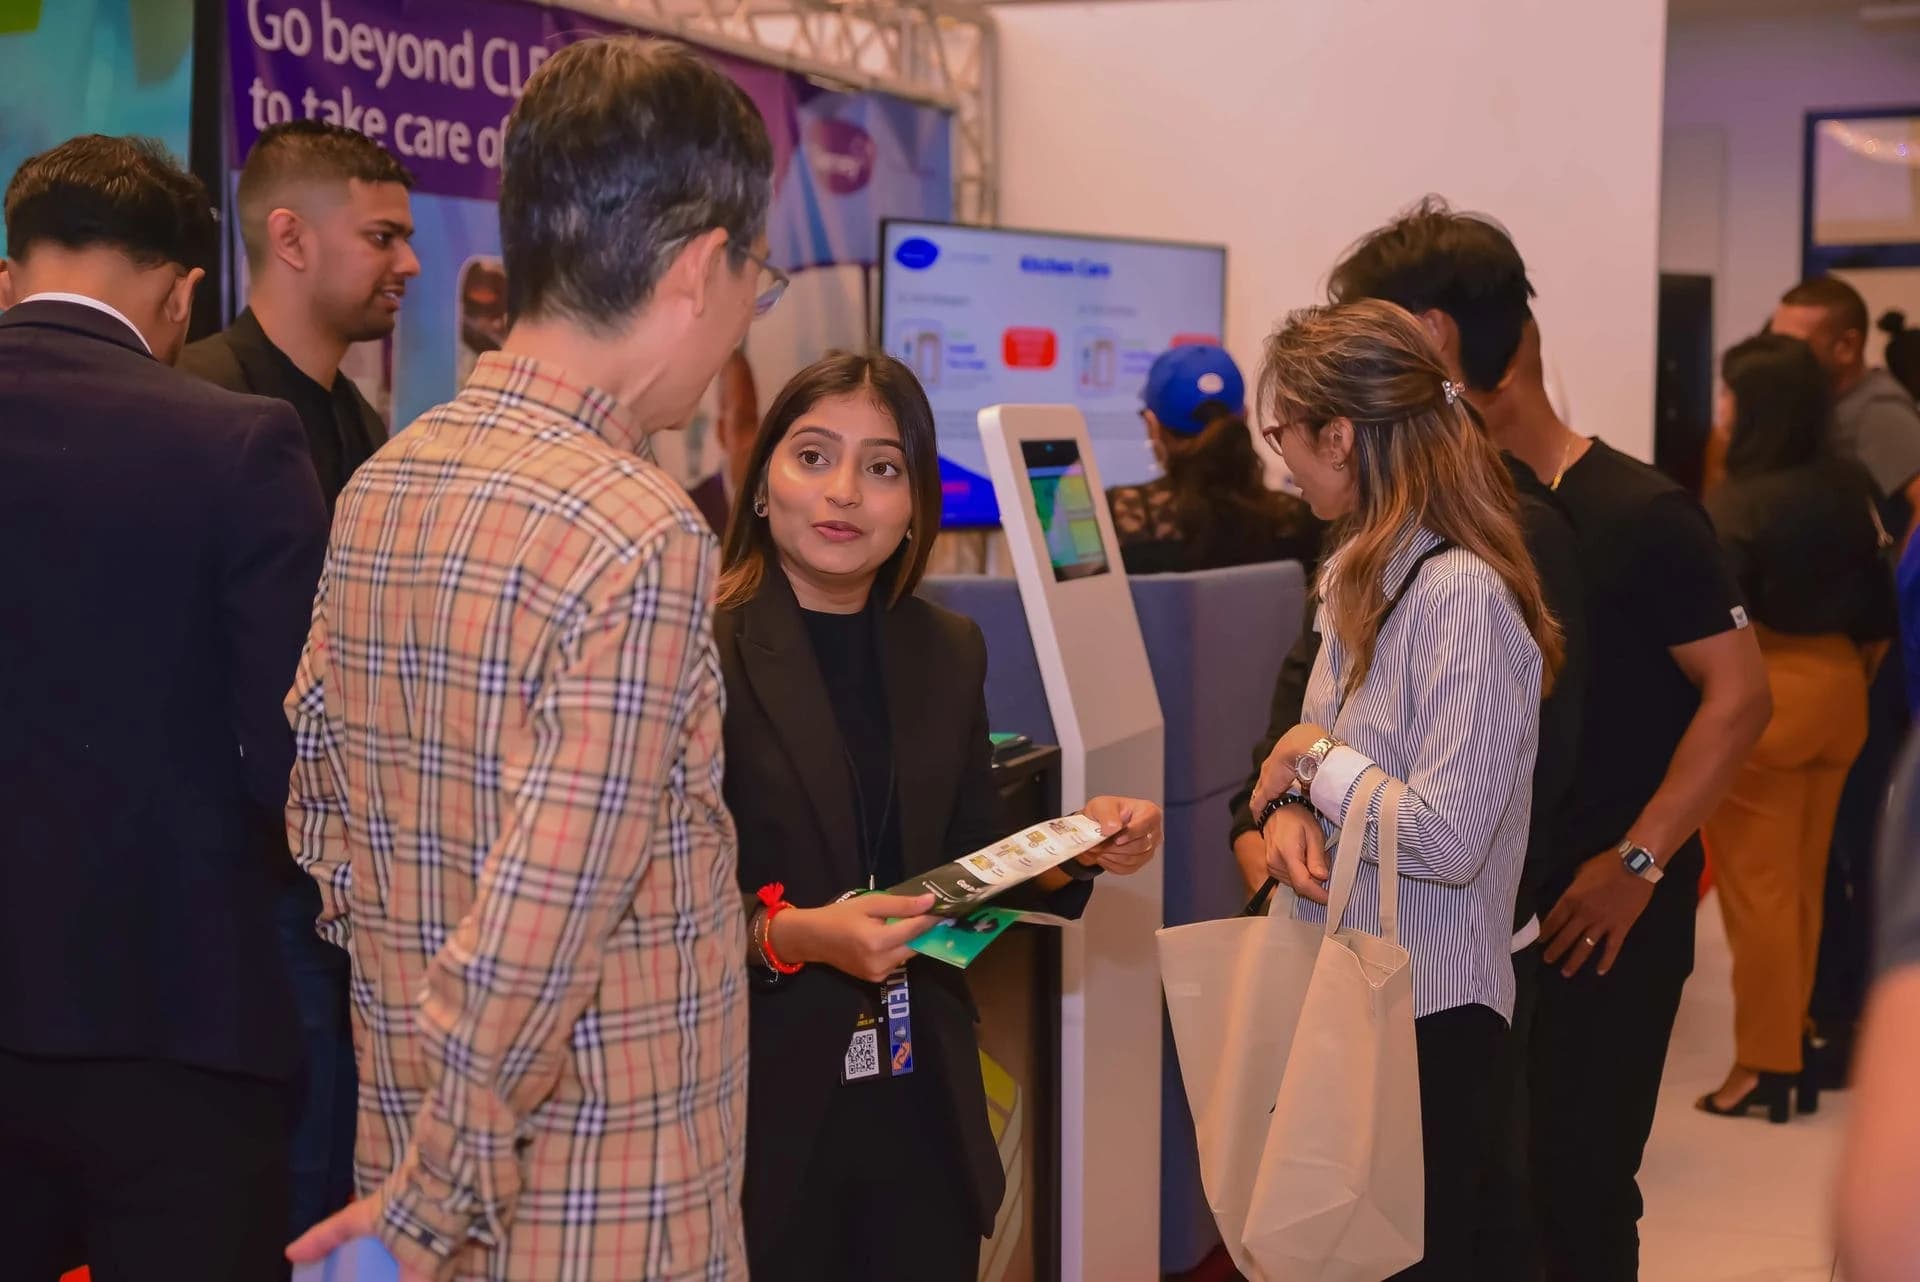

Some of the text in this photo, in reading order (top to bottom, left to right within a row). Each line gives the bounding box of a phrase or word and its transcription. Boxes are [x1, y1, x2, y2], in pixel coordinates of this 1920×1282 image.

[247, 0, 312, 57] Go
[321, 0, 475, 89] beyond
[247, 77, 293, 131] to
[301, 86, 387, 148] take
[394, 112, 472, 164] care
